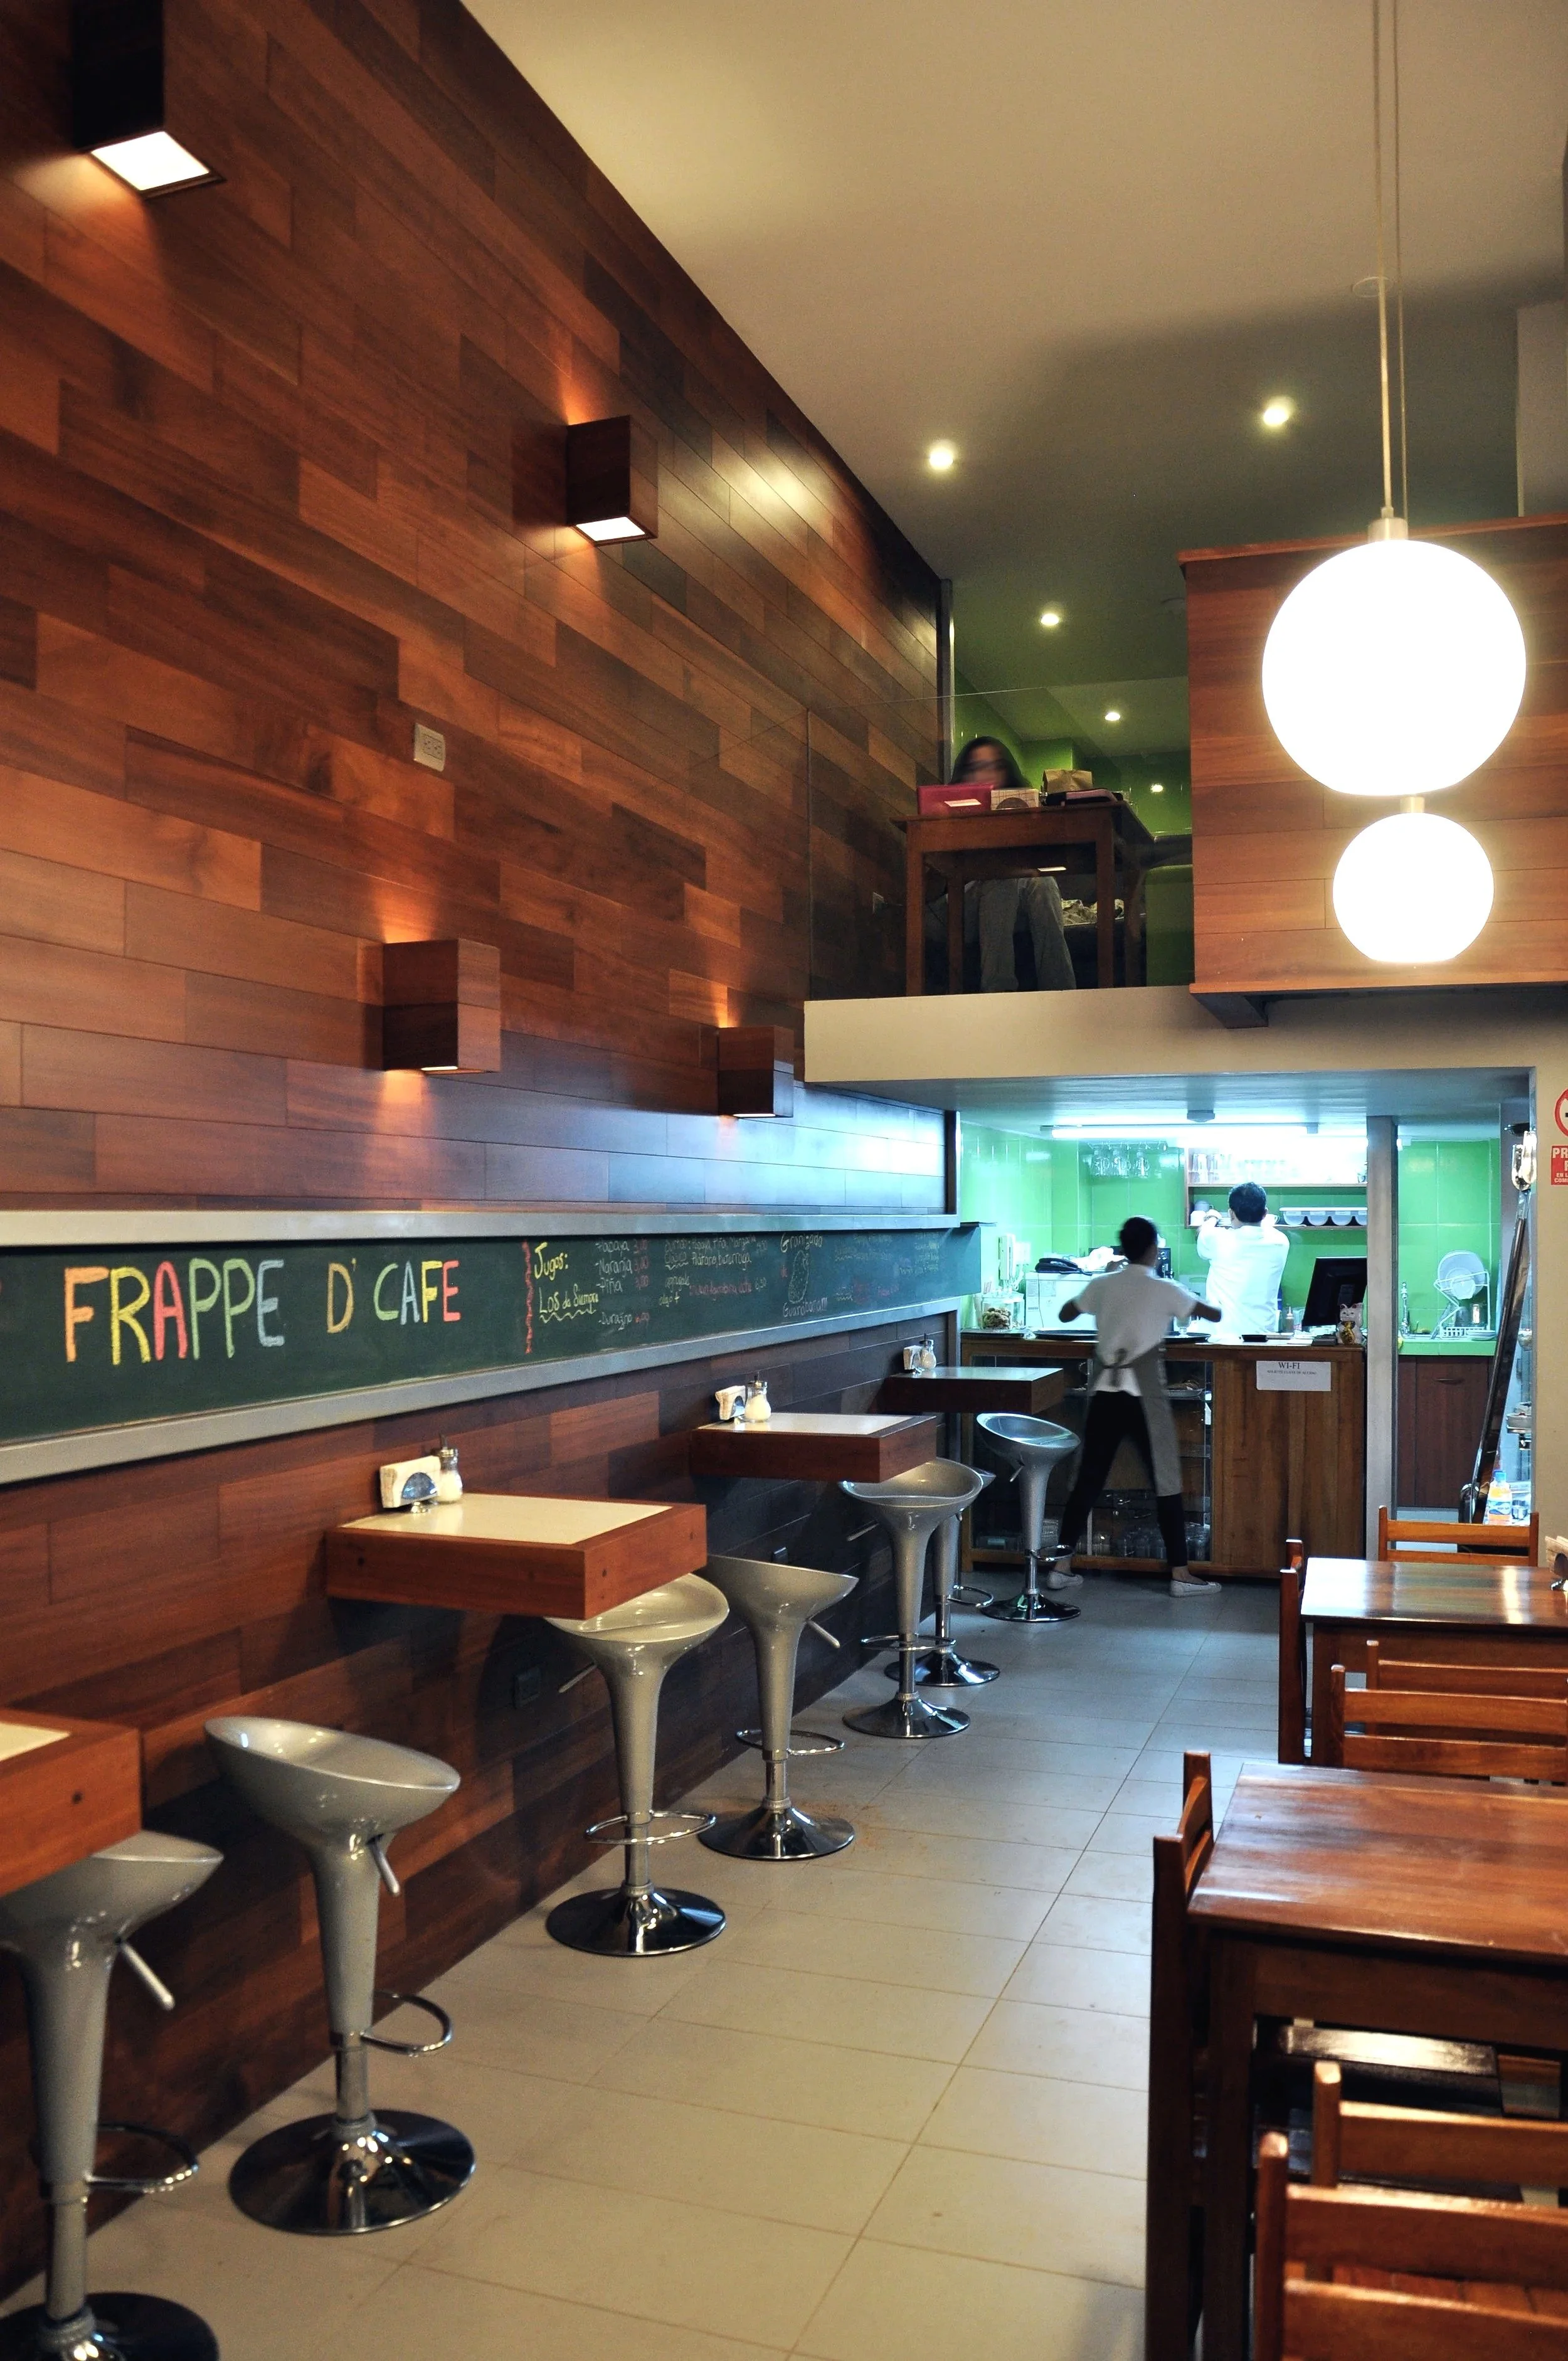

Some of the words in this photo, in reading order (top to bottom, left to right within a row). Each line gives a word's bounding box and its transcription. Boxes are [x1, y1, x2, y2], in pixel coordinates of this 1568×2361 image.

[534, 1241, 568, 1281] Jugos:
[65, 1258, 284, 1365] FRAPPE
[374, 1260, 461, 1325] CAFE
[539, 1287, 559, 1313] Los
